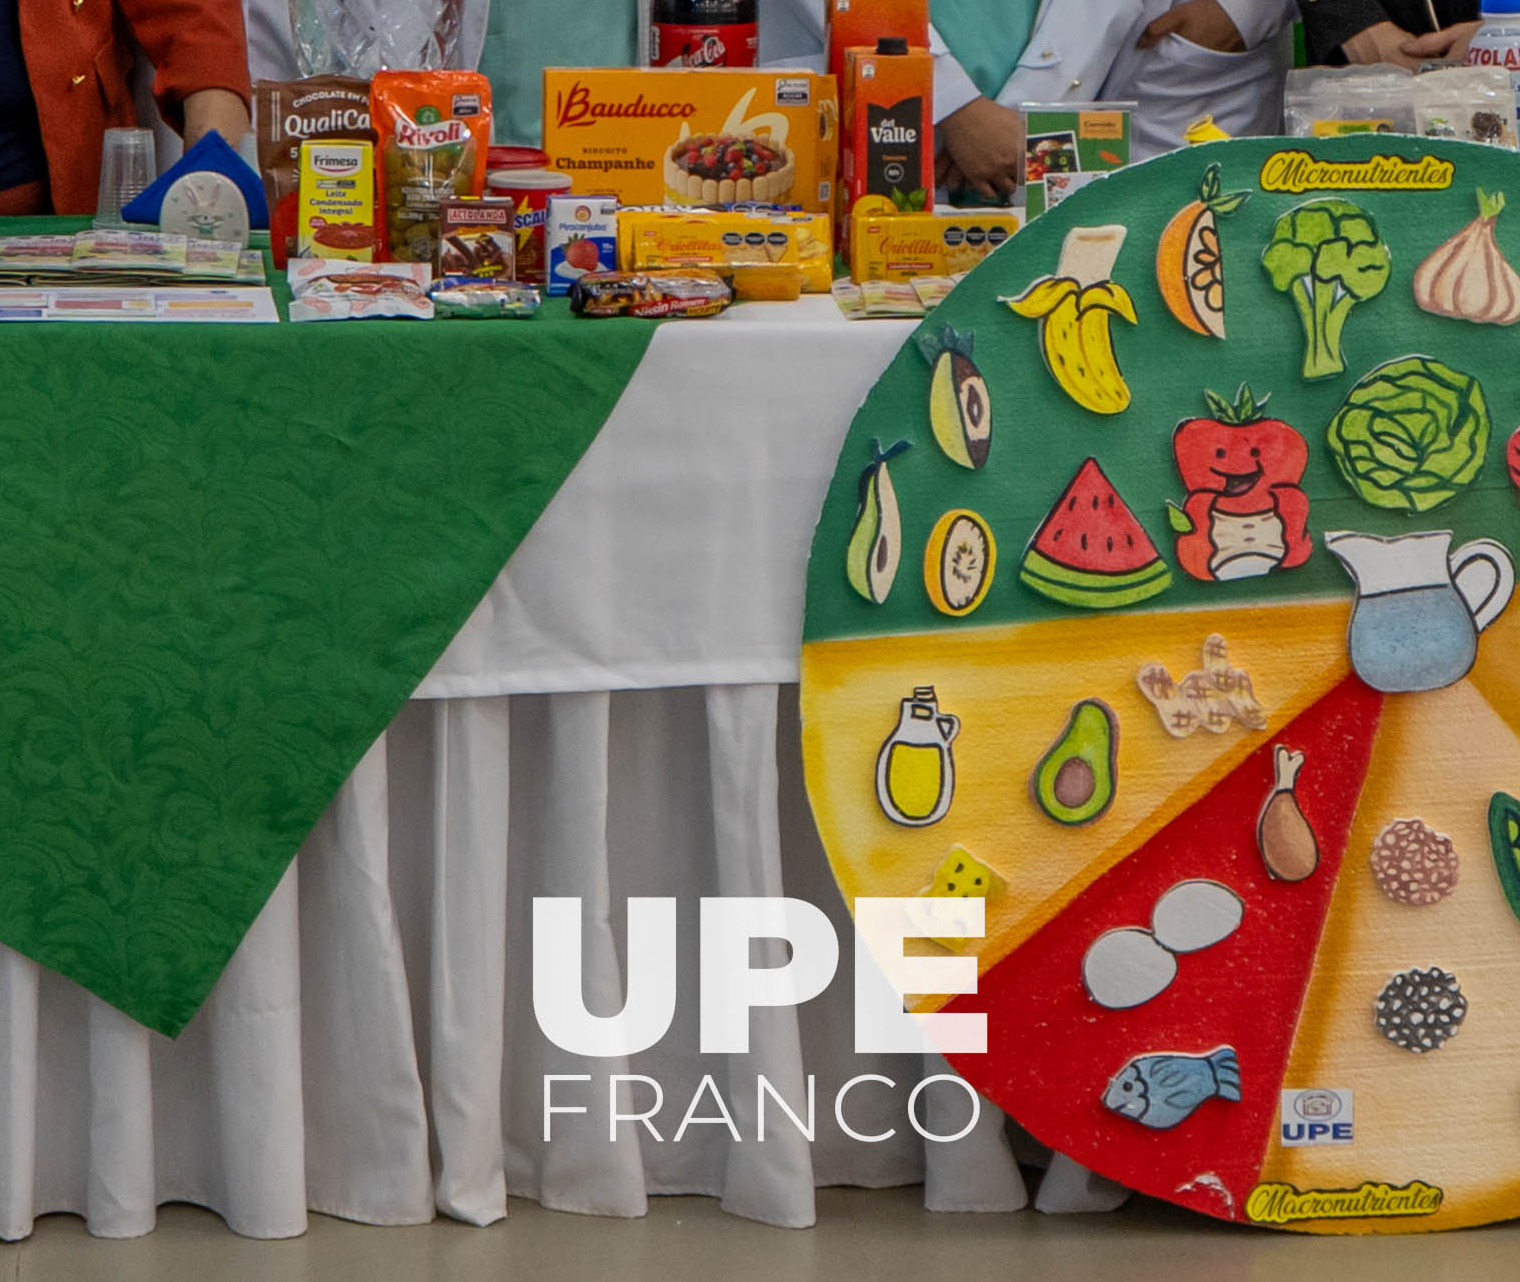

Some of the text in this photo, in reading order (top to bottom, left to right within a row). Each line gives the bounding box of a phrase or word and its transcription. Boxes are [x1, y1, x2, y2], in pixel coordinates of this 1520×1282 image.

[292, 90, 346, 108] CHOCOLATE
[557, 80, 697, 129] Bauducco
[284, 109, 371, 139] QualiCa
[880, 118, 896, 127] del
[398, 122, 461, 146] Rivoli
[870, 126, 917, 144] Valle
[582, 146, 628, 155] BISCOITO
[313, 154, 359, 167] Frimesa
[555, 156, 656, 172] Champanhe
[1266, 156, 1450, 187] Micronutrientes
[634, 302, 669, 316] Nissin
[1282, 1122, 1354, 1142] UPE
[1252, 1184, 1442, 1216] Macronutrientes
